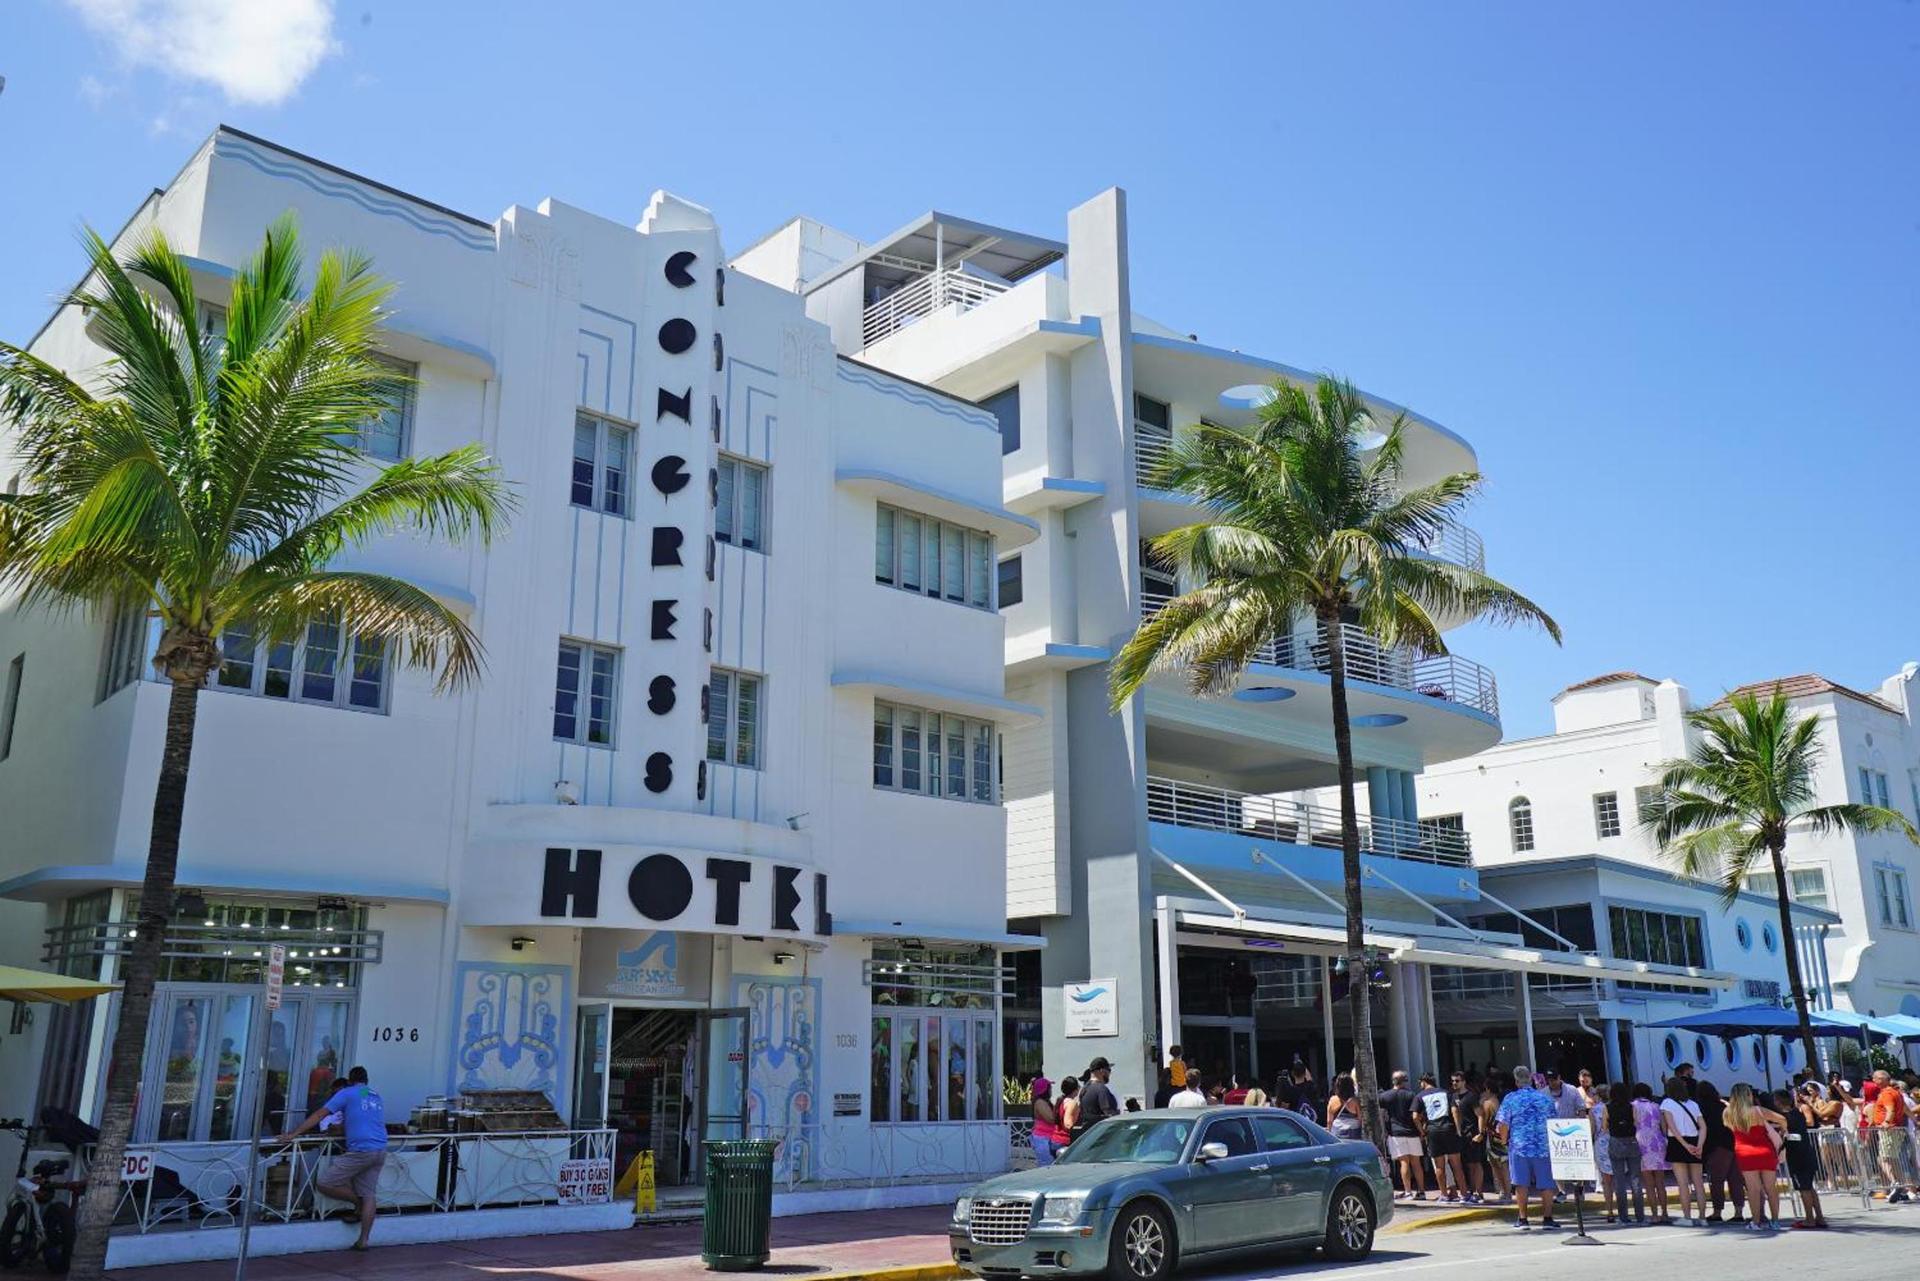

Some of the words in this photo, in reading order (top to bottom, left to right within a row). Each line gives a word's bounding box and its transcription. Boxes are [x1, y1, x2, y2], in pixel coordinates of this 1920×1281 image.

[644, 251, 697, 794] CONGRESS
[541, 848, 832, 936] HOTEL
[373, 1027, 419, 1042] 1036
[836, 1034, 857, 1048] 1036
[1552, 1139, 1589, 1151] VALET
[560, 1169, 574, 1182] BUY
[586, 1183, 608, 1197] FREE
